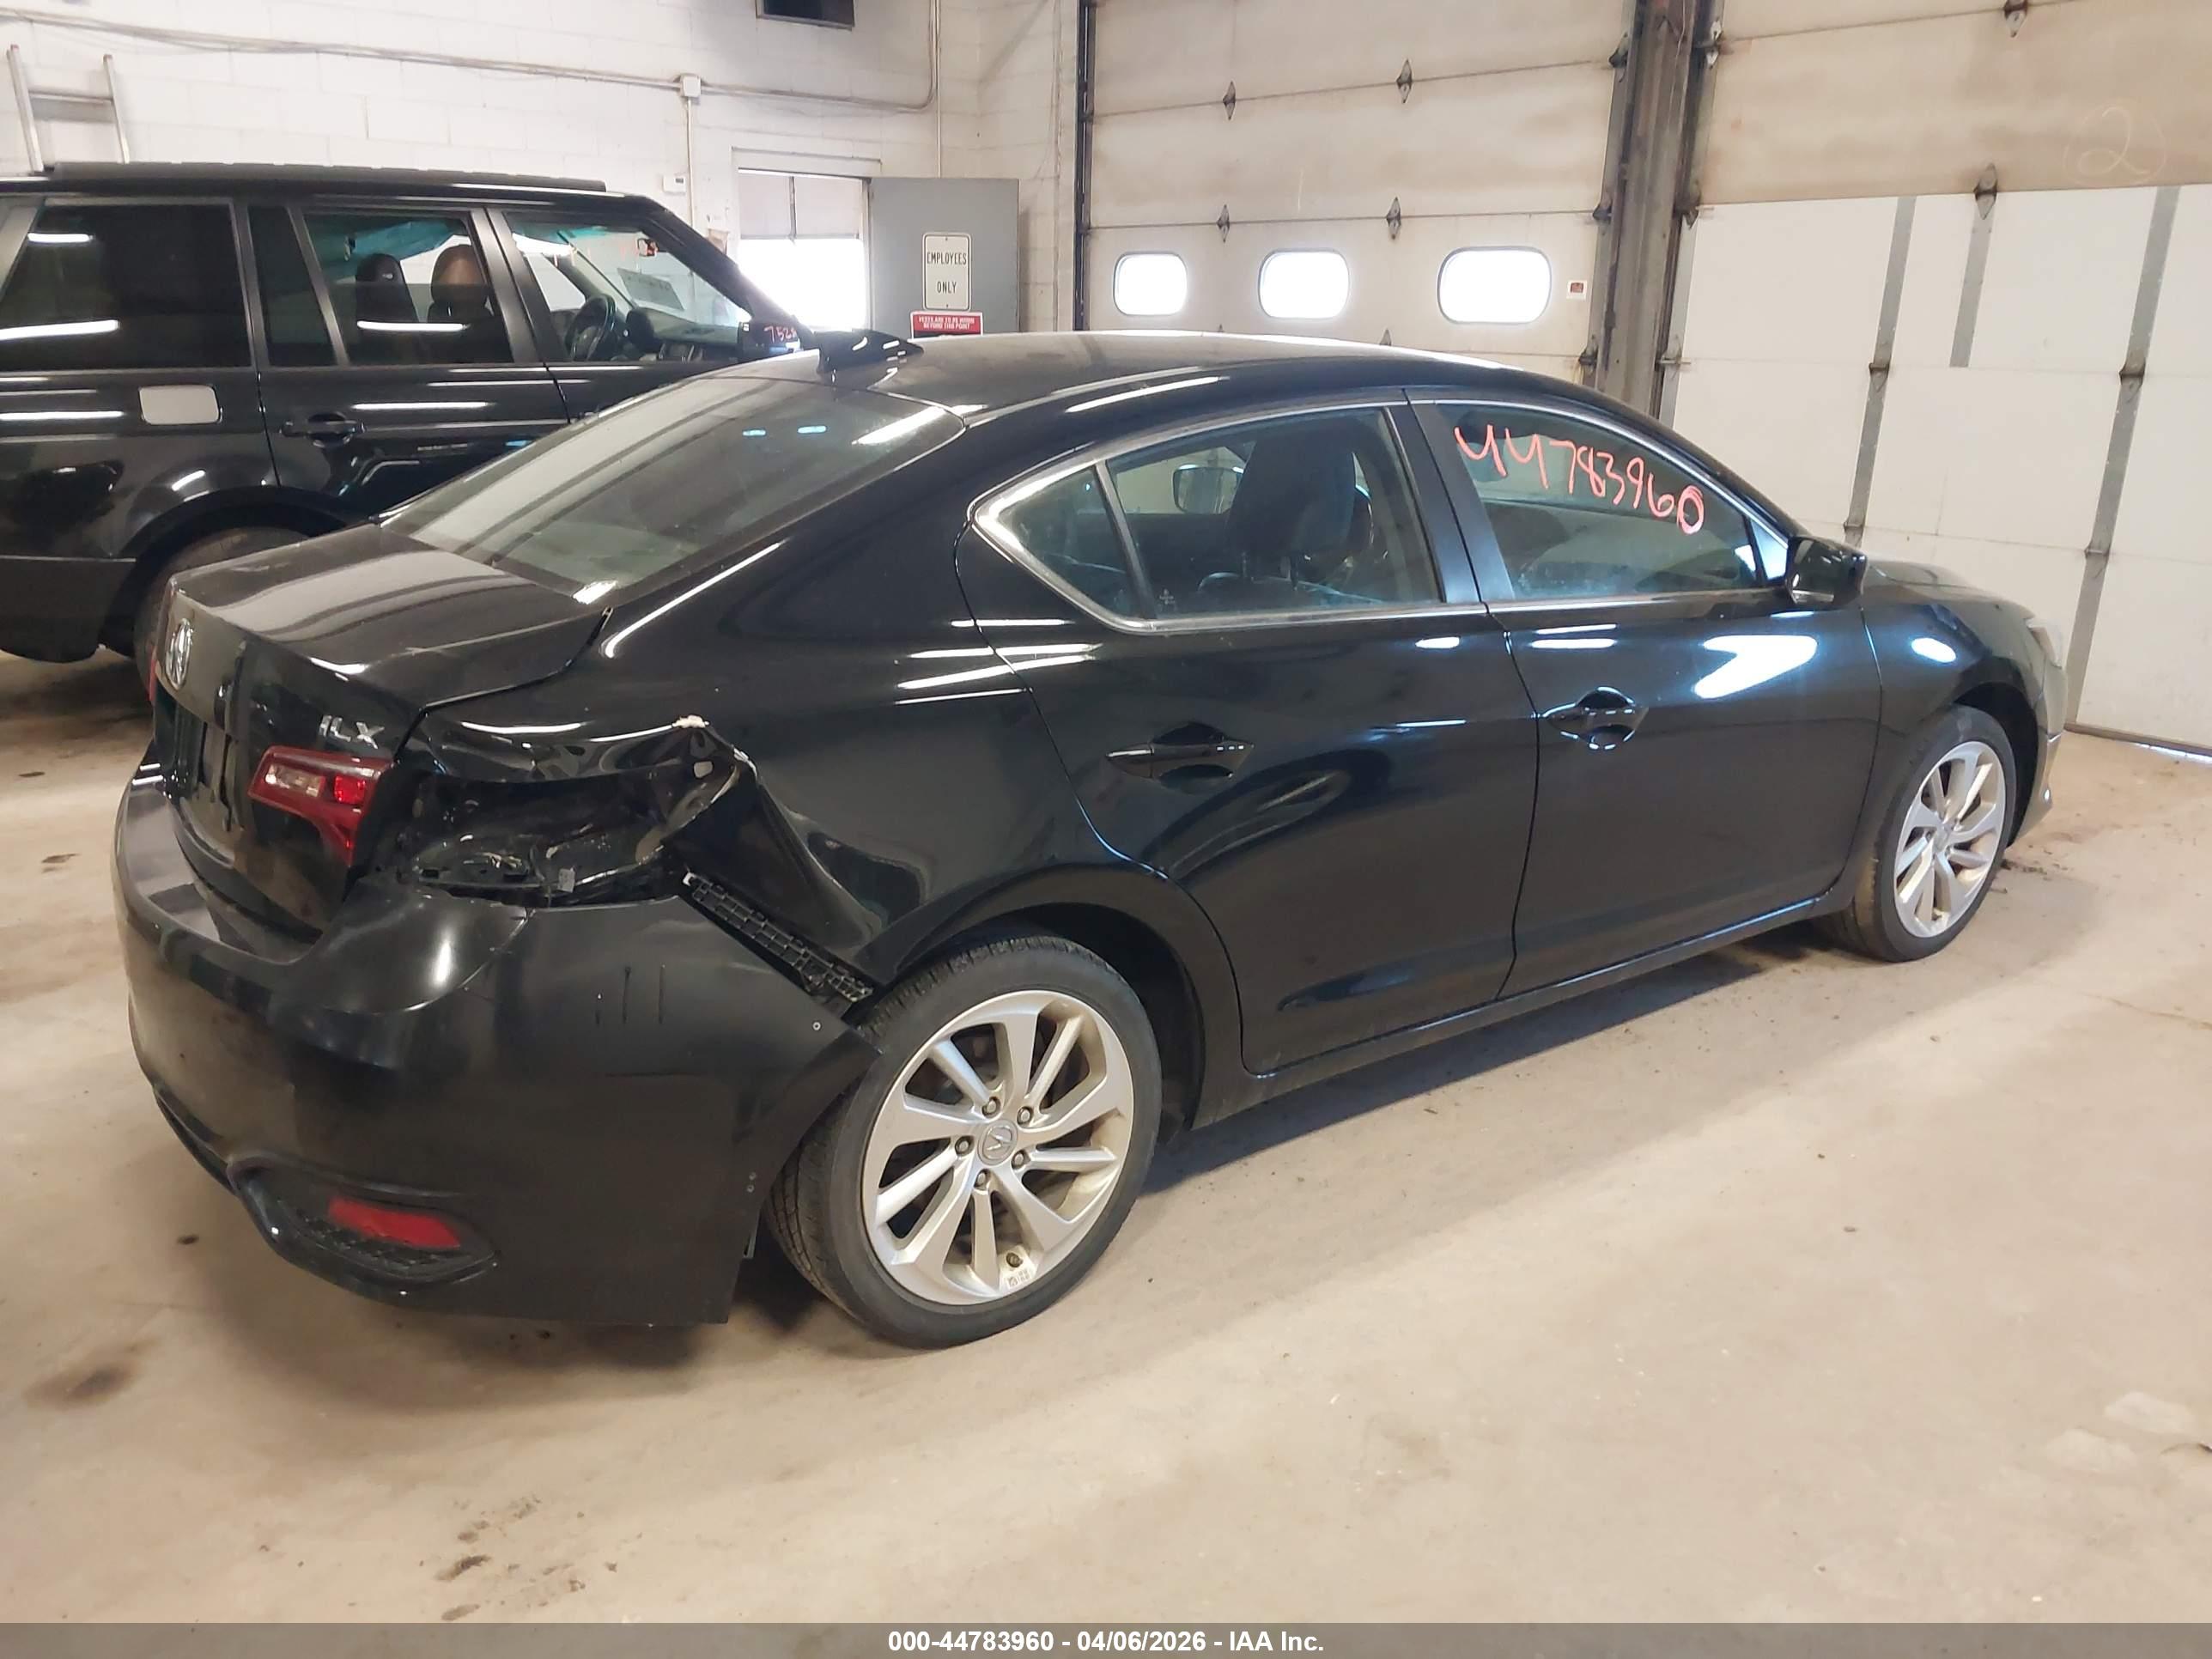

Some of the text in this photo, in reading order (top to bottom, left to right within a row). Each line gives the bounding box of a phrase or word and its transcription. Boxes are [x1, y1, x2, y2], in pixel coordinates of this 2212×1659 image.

[927, 252, 967, 265] EMPLOYEES
[937, 281, 957, 294] ONLY
[1455, 424, 1705, 534] 44783960
[319, 715, 386, 750] ILX
